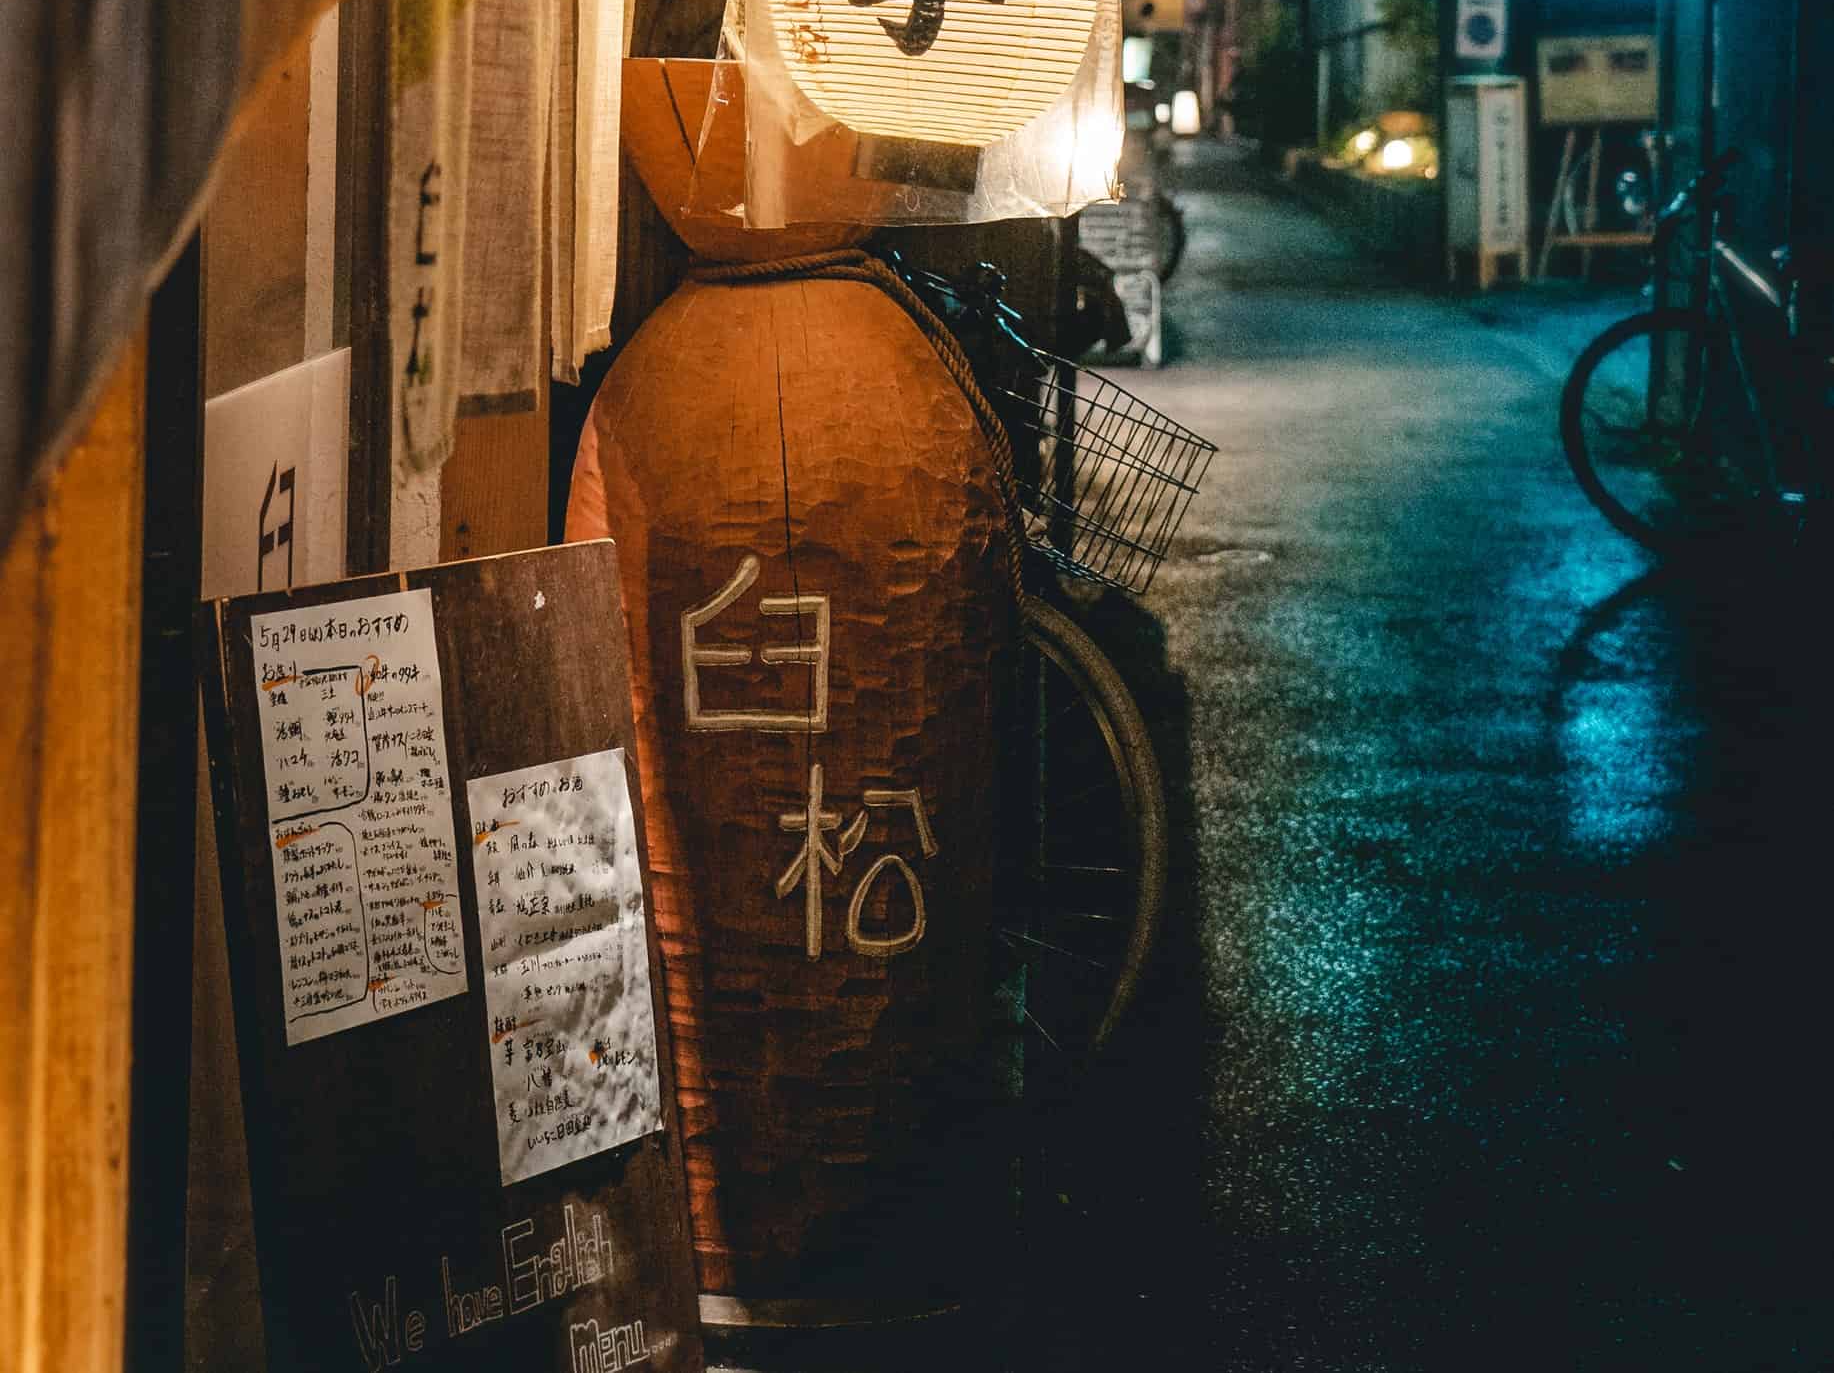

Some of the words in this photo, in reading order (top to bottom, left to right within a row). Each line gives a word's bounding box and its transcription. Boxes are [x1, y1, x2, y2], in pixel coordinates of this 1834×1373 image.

[680, 554, 939, 963] 臼松
[351, 1274, 426, 1373] We
[502, 1203, 614, 1316] English
